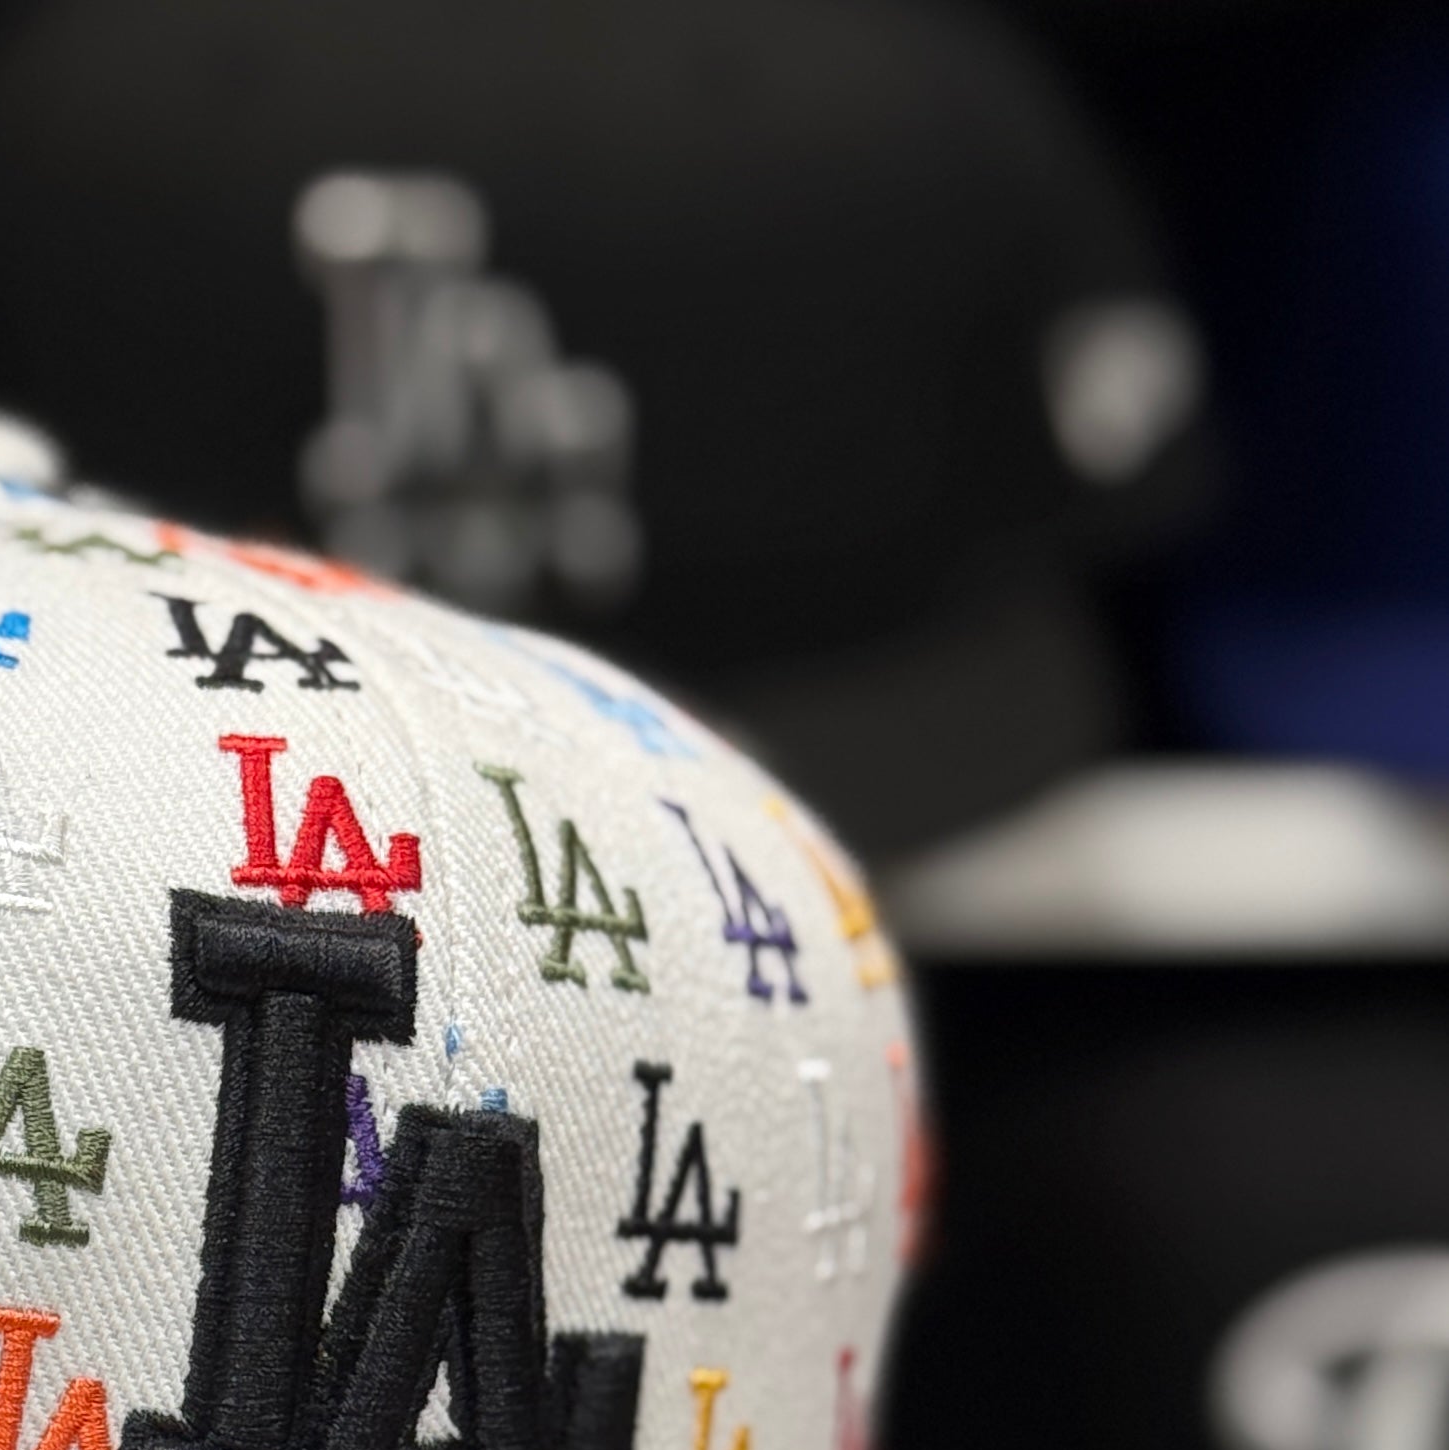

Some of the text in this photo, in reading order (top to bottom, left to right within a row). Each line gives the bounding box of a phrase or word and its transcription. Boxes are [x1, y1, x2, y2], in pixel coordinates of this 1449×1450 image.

[150, 590, 359, 691] LA
[219, 733, 423, 915] LA
[473, 762, 652, 994] LA
[659, 796, 810, 1006] LA
[616, 1060, 741, 1302] LA
